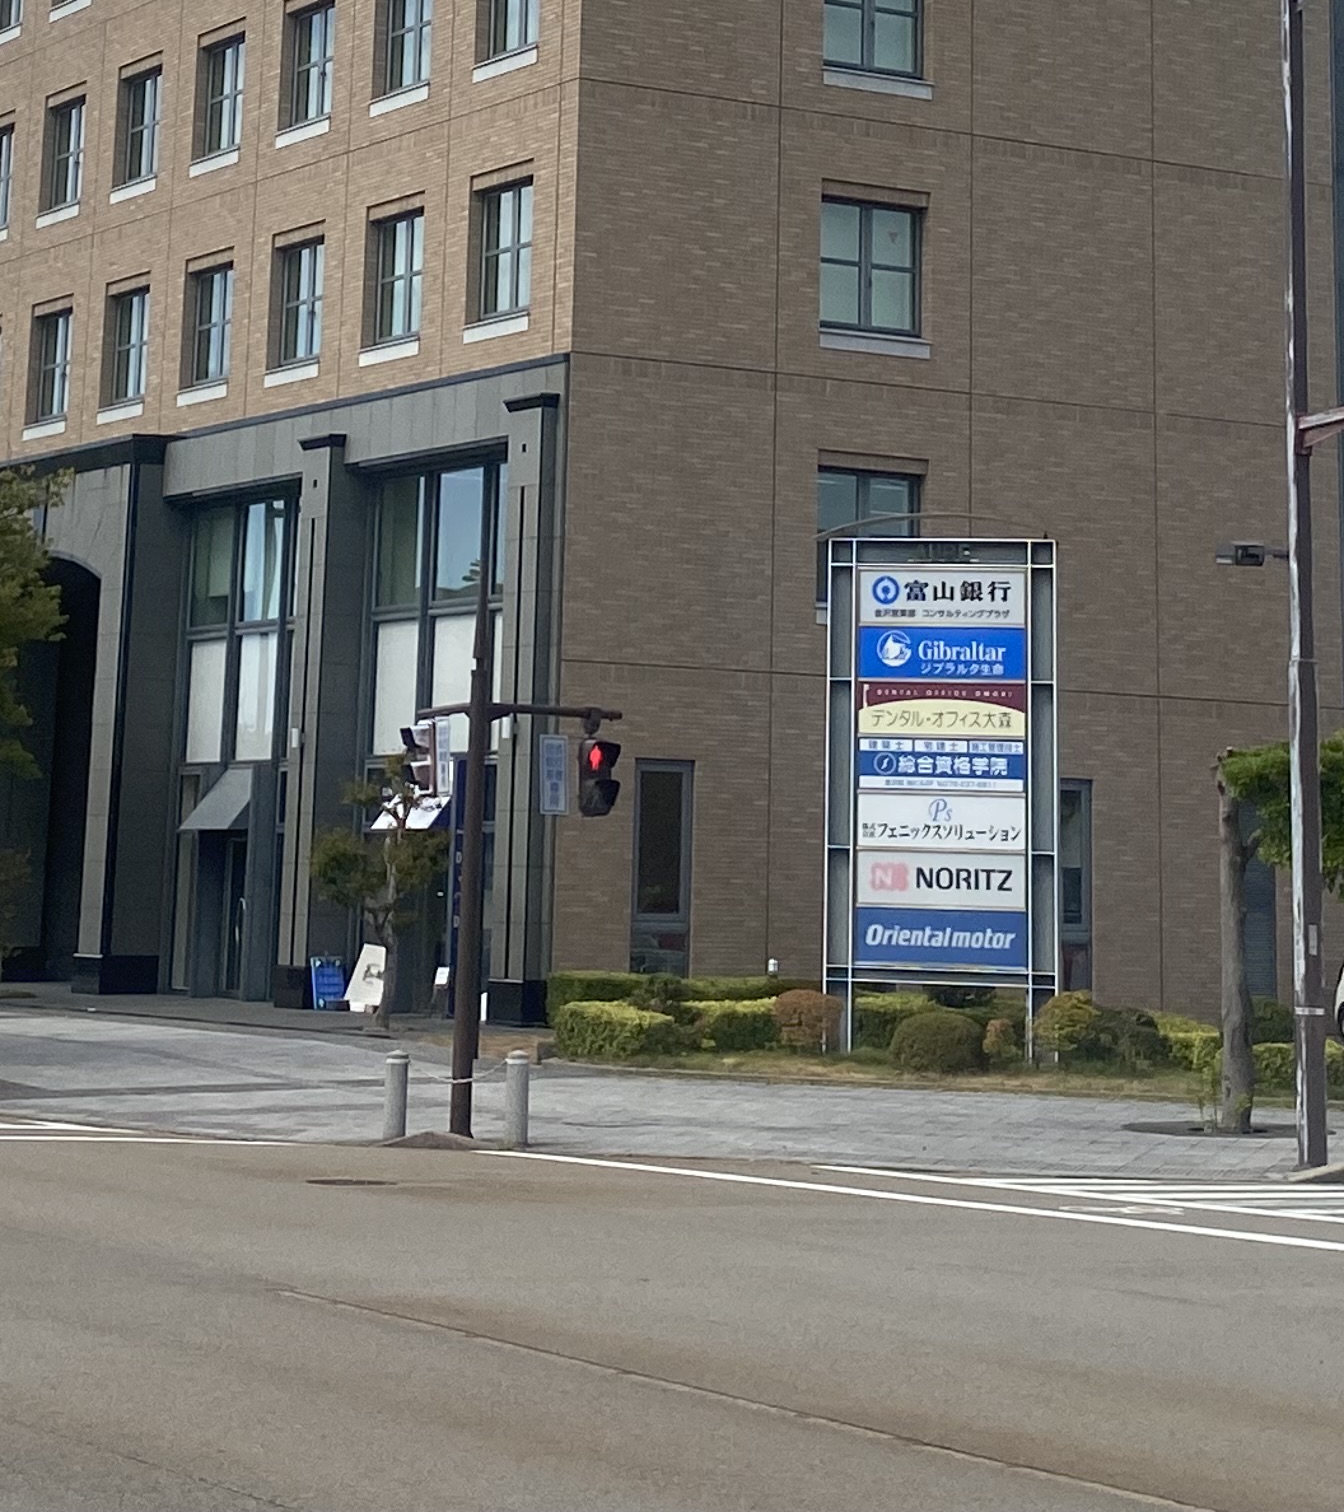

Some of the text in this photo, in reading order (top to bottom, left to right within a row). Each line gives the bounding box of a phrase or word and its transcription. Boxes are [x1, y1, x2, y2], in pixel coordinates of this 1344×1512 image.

[903, 579, 1012, 603] 富山銀行
[918, 640, 1006, 662] Gibraltar
[871, 709, 1012, 729] デンタル・オフィス大森
[898, 755, 1008, 776] 総合資格学院
[916, 867, 1013, 891] NORITZ
